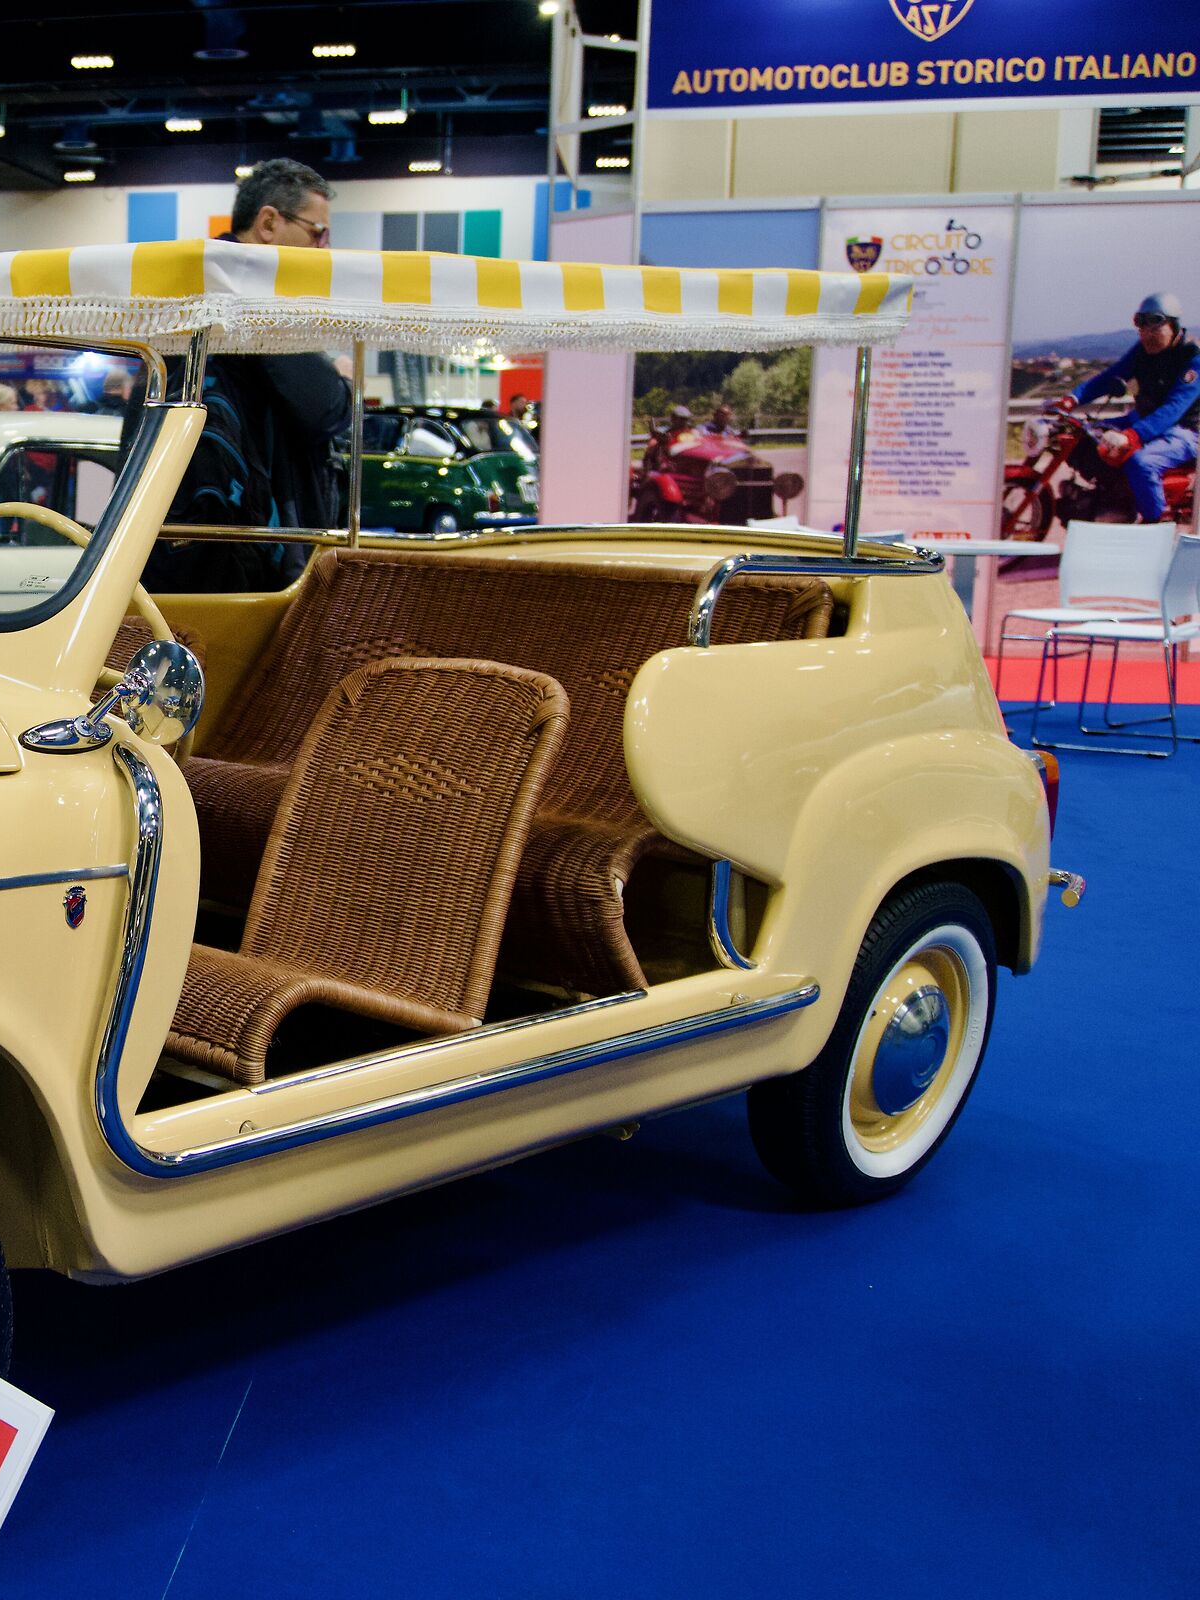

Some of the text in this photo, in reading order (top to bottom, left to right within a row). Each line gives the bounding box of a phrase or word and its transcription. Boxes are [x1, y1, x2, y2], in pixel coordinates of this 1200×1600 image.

[672, 51, 1197, 95] AUTOMOTOCLUB STORICO ITALIANO
